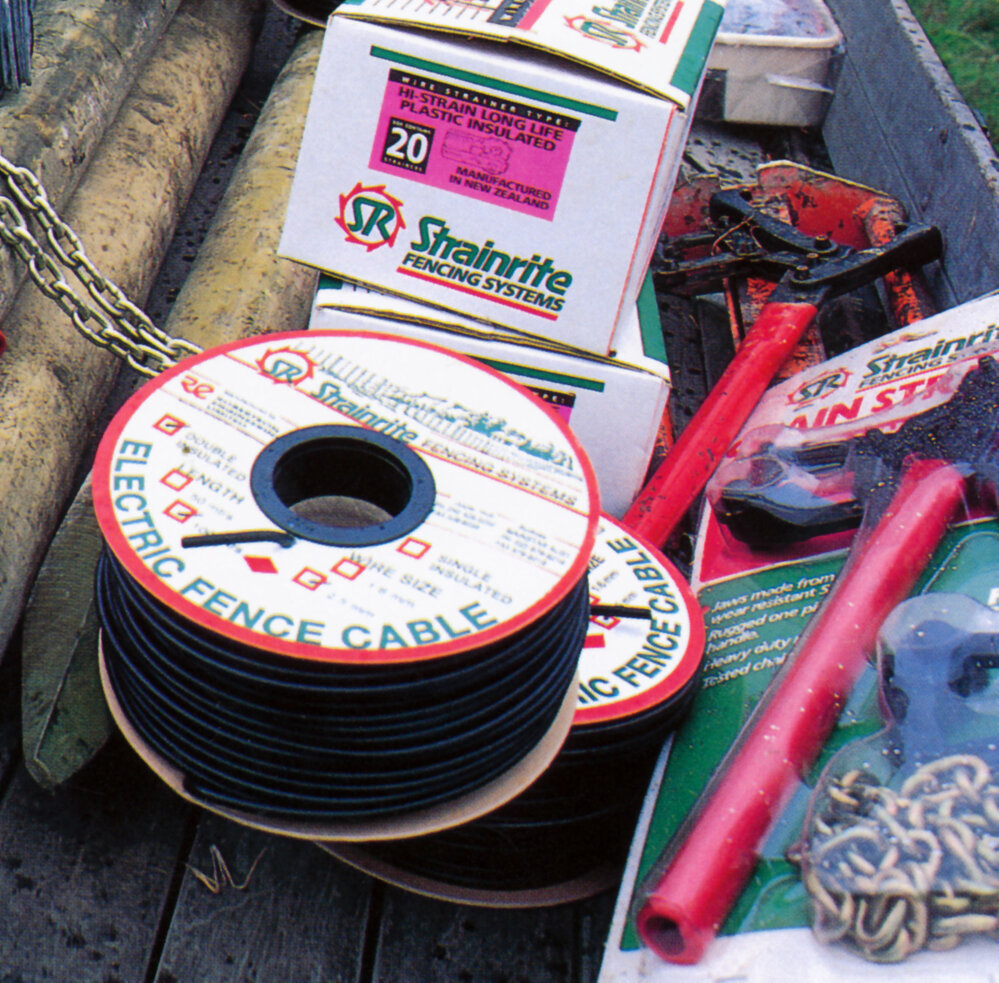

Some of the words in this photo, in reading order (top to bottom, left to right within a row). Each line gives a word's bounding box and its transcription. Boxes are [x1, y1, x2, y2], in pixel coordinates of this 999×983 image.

[398, 86, 477, 117] HI-STRAIN
[480, 109, 526, 132] LONG
[530, 122, 564, 142] LIFE
[401, 76, 436, 91] WIRE
[445, 87, 517, 114] STRAINER
[526, 109, 570, 128] TYPE:
[385, 126, 429, 164] 20
[400, 100, 463, 126] PLASTIC
[467, 117, 556, 152] INSULATED
[449, 174, 461, 185] IN
[463, 178, 491, 194] NEW
[493, 187, 550, 211] ZEALAND
[455, 166, 552, 201] MANUFACTURED
[346, 195, 395, 241] SR
[410, 215, 574, 297] Strainrite
[402, 252, 483, 287] FENCING
[481, 276, 566, 313] SYSTEMS
[269, 359, 302, 384] SR
[862, 322, 999, 379] Strainri
[799, 373, 842, 402] SR
[185, 432, 237, 464] DOUBLE
[311, 380, 419, 442] Strainrite
[421, 438, 495, 474] FENCING
[496, 468, 578, 506] SYSTEMS
[176, 462, 245, 505] LENGTH
[113, 438, 186, 578] ELECTRIC
[181, 578, 325, 649] FENCE
[341, 601, 499, 650] CABLE
[349, 551, 396, 578] WIRE
[399, 573, 444, 599] SIZE
[429, 563, 513, 606] INSULATED
[437, 554, 493, 583] SINGLE
[606, 535, 680, 615] CABLE
[711, 594, 749, 613] Jaws
[750, 582, 794, 602] made
[797, 572, 836, 590] from
[711, 605, 750, 625] wear
[751, 587, 817, 613] resistant
[707, 613, 768, 642] Rugged
[769, 608, 800, 623] one
[801, 600, 821, 618] pi
[611, 616, 682, 688] FENCE
[702, 661, 752, 689] Tested
[752, 651, 789, 672] chai
[703, 647, 753, 672] Heavy
[754, 636, 793, 655] duty
